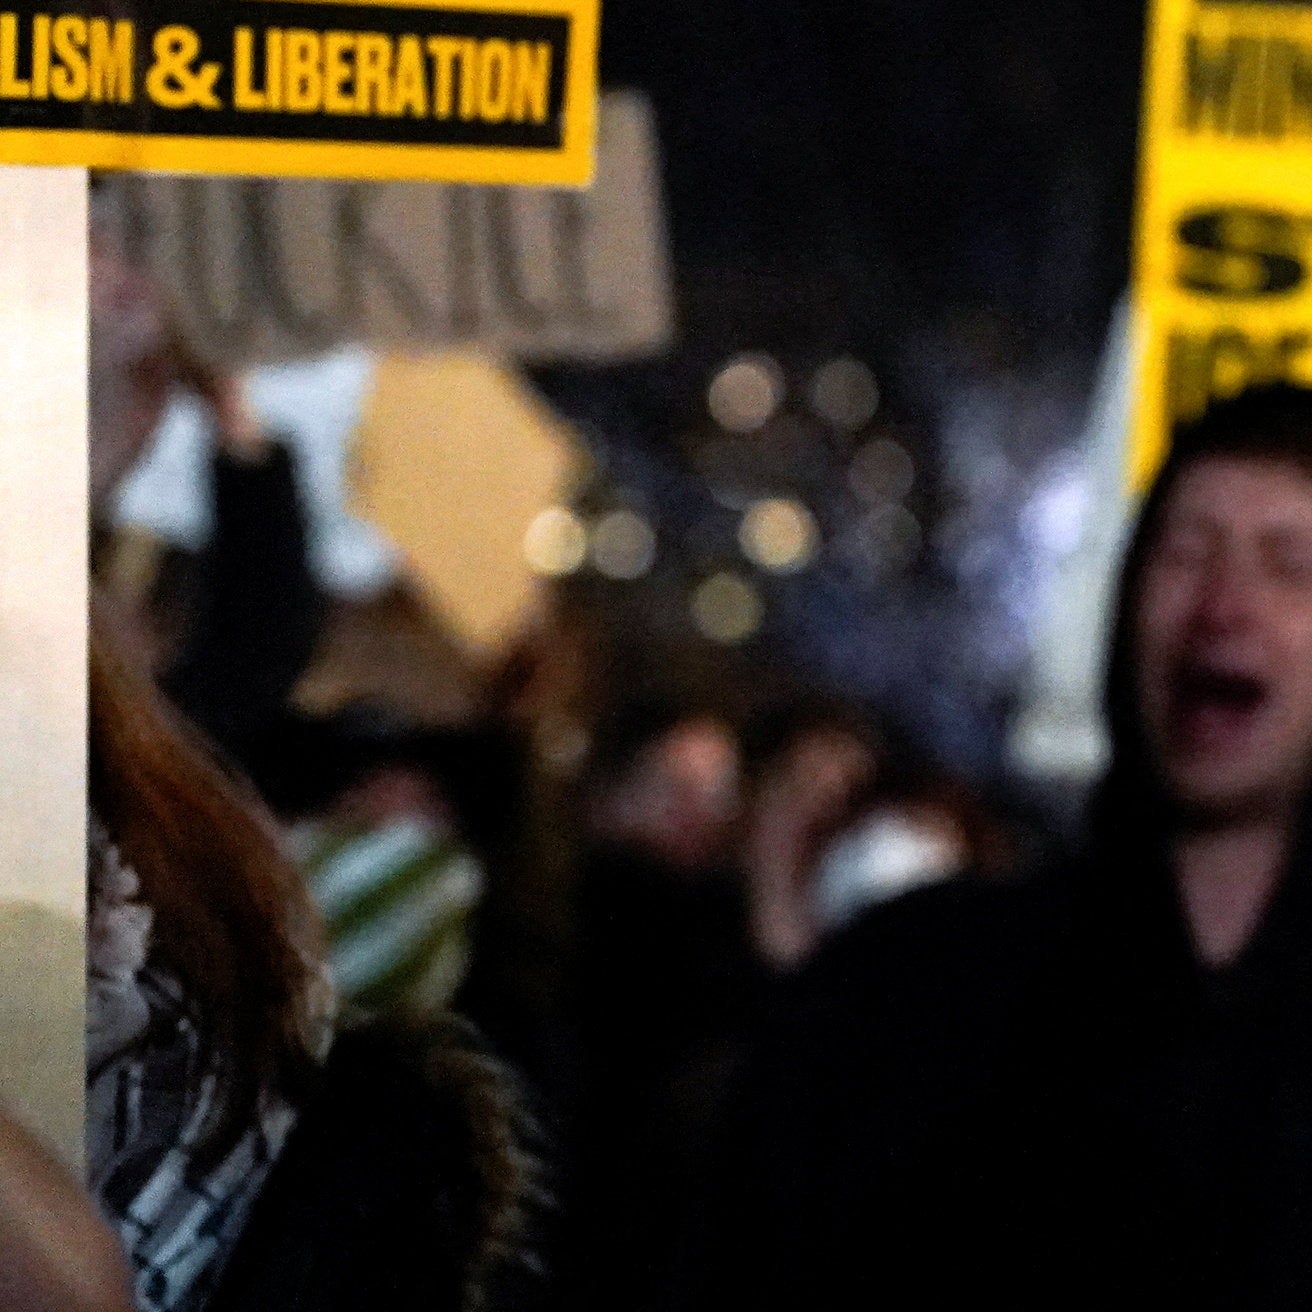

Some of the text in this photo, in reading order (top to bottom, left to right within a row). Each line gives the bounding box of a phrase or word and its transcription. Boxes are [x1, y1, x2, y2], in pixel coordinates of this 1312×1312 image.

[0, 11, 552, 125] LISM & LIBERATION
